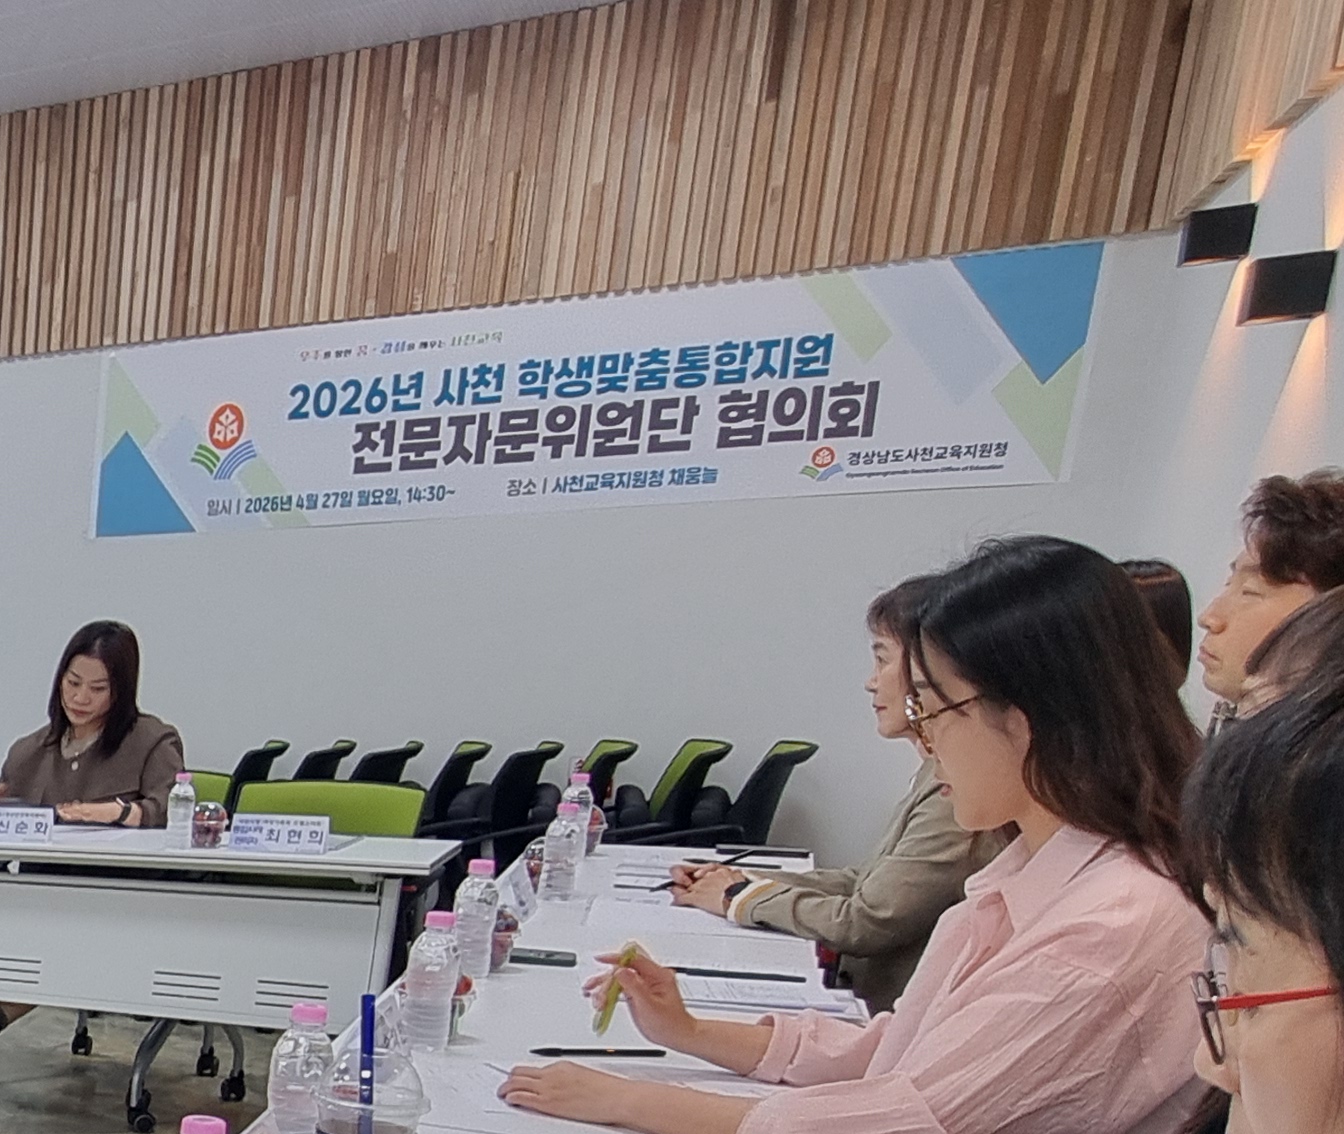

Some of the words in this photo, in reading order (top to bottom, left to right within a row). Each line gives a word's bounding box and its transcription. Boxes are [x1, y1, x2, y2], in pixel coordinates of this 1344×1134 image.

[286, 369, 424, 421] 2026년
[433, 361, 505, 407] 사천
[516, 332, 834, 402] 학생맞춤통합지원
[351, 394, 701, 476] 전문자문위원단
[715, 379, 882, 449] 협의회
[846, 441, 1009, 466] 경상남도사천교육지원청
[506, 478, 537, 497] 장소
[552, 469, 664, 494] 사천교육지원청
[207, 499, 232, 516] 일시
[244, 494, 293, 513] 2026년
[295, 492, 319, 510] 4월
[321, 490, 354, 509] 27일
